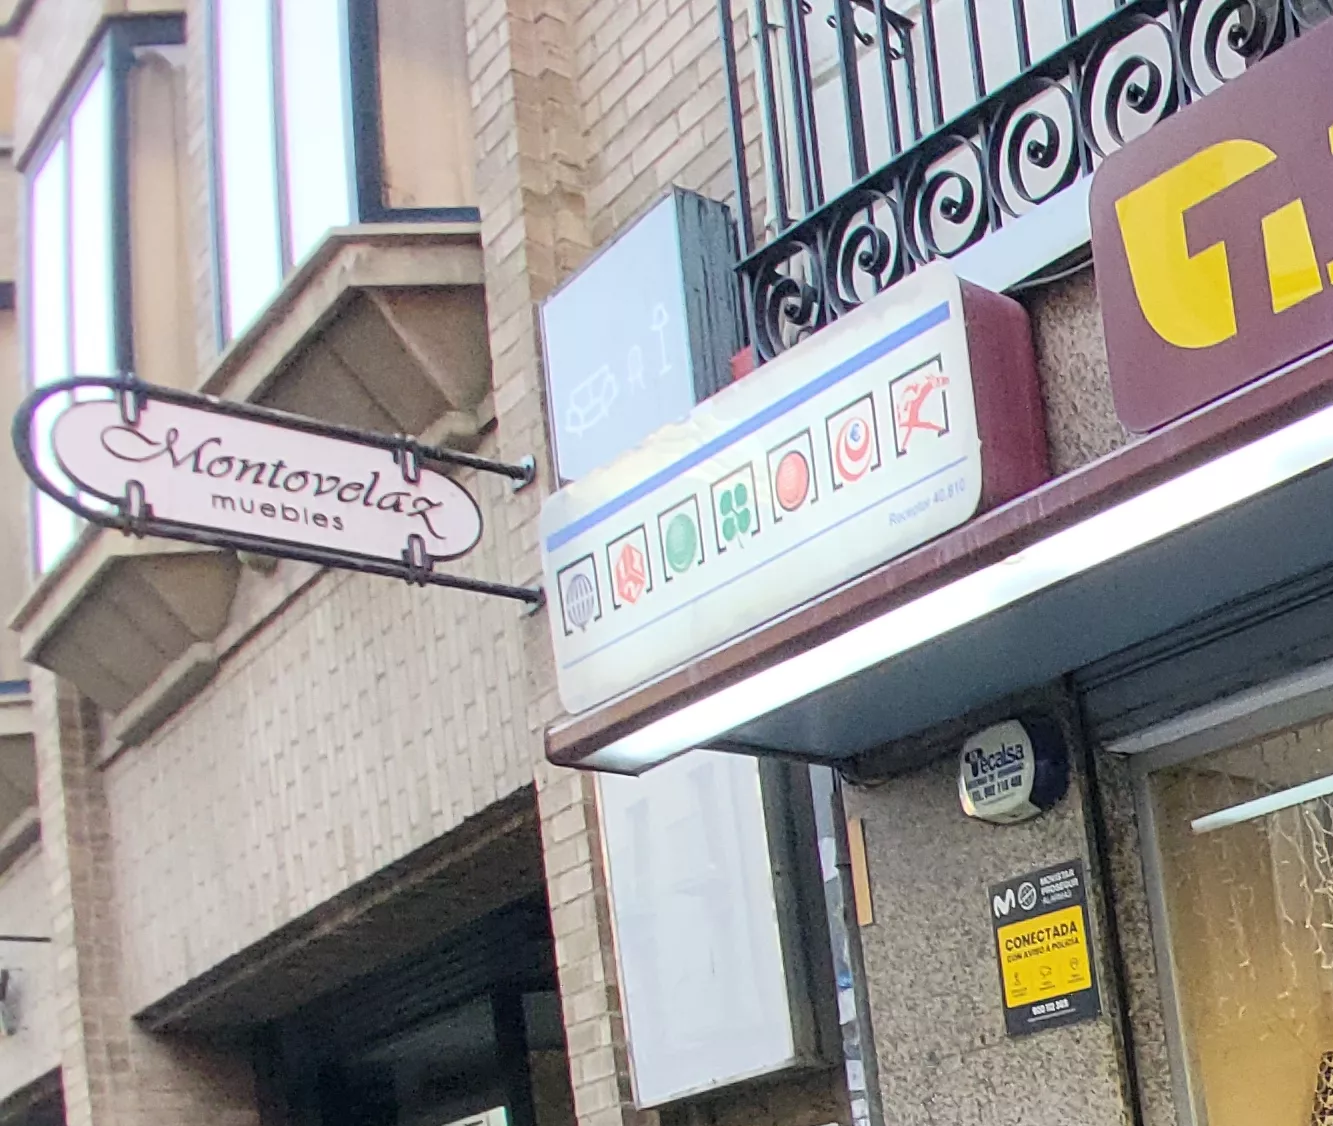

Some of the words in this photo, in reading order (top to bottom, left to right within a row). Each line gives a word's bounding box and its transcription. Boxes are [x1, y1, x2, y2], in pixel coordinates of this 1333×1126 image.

[100, 425, 447, 540] Montovelaz
[211, 493, 345, 531] muebles
[964, 743, 1025, 778] Tecalsa
[1005, 920, 1079, 952] CONECTADA
